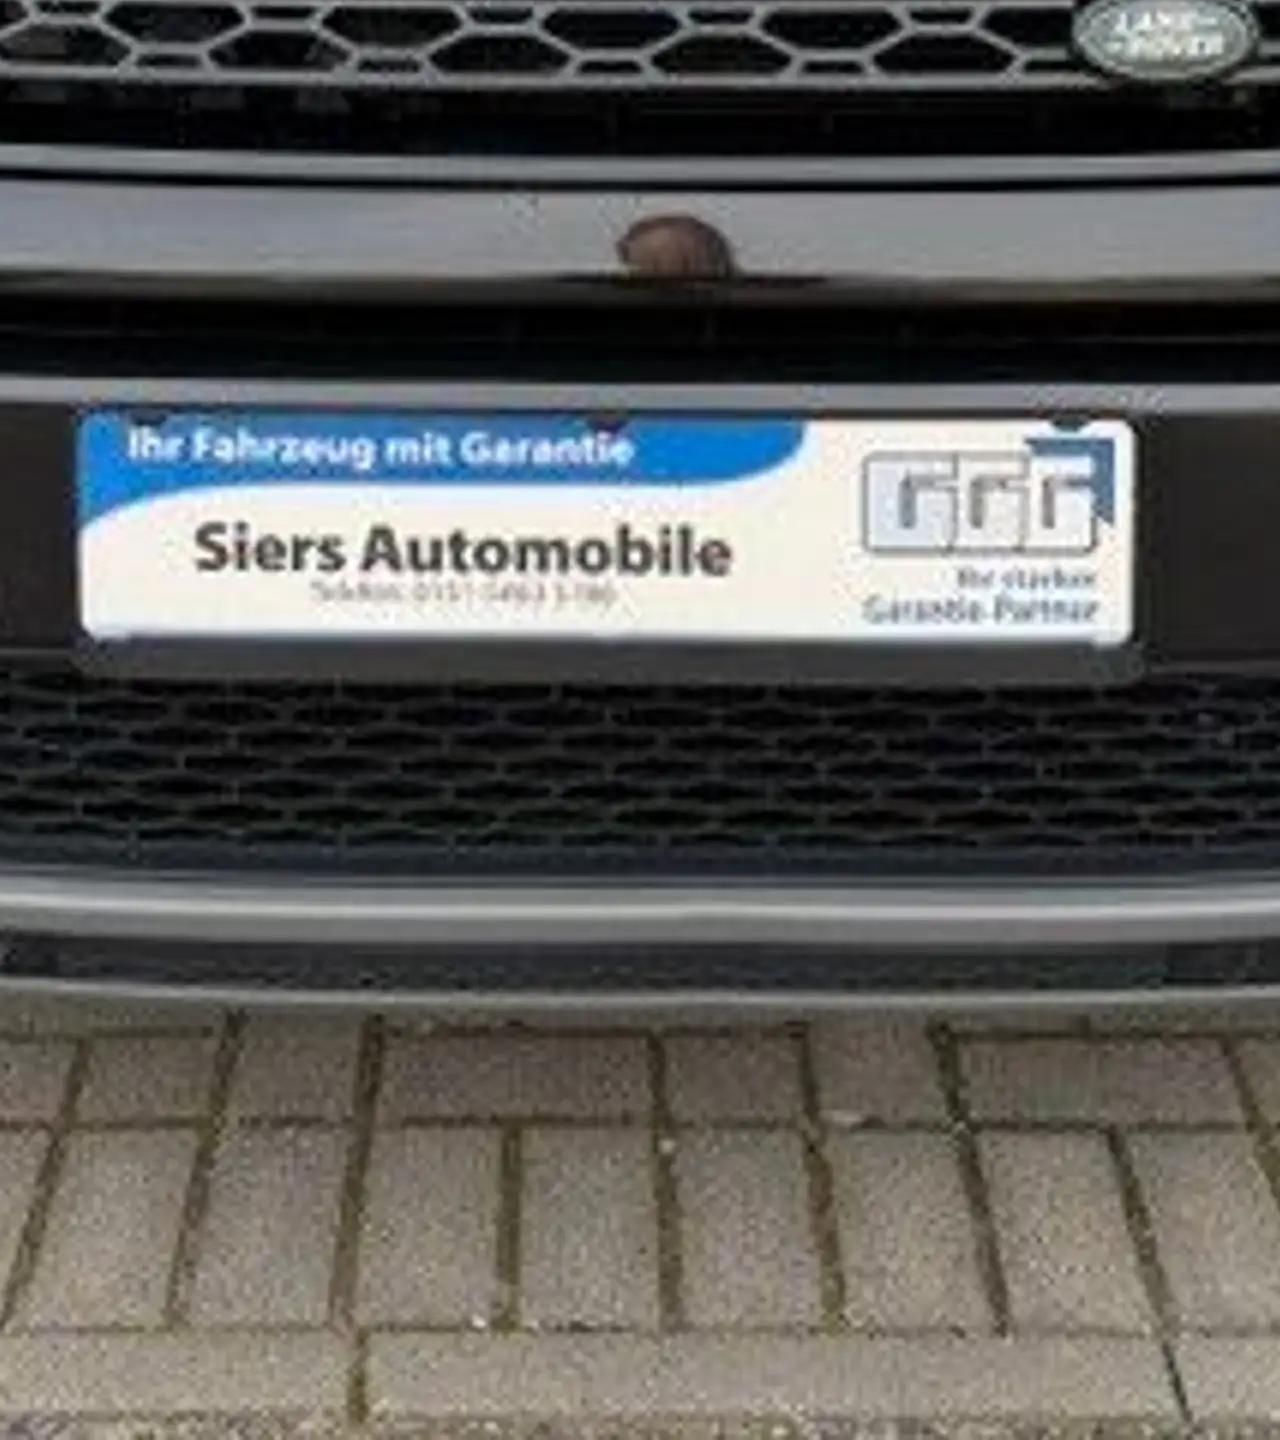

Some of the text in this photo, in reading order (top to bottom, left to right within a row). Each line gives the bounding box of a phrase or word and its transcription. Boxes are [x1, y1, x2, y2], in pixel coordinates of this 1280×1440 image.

[127, 428, 635, 469] Ihr Fahrzeug mit Garantie
[193, 521, 733, 577] Siers Automobile
